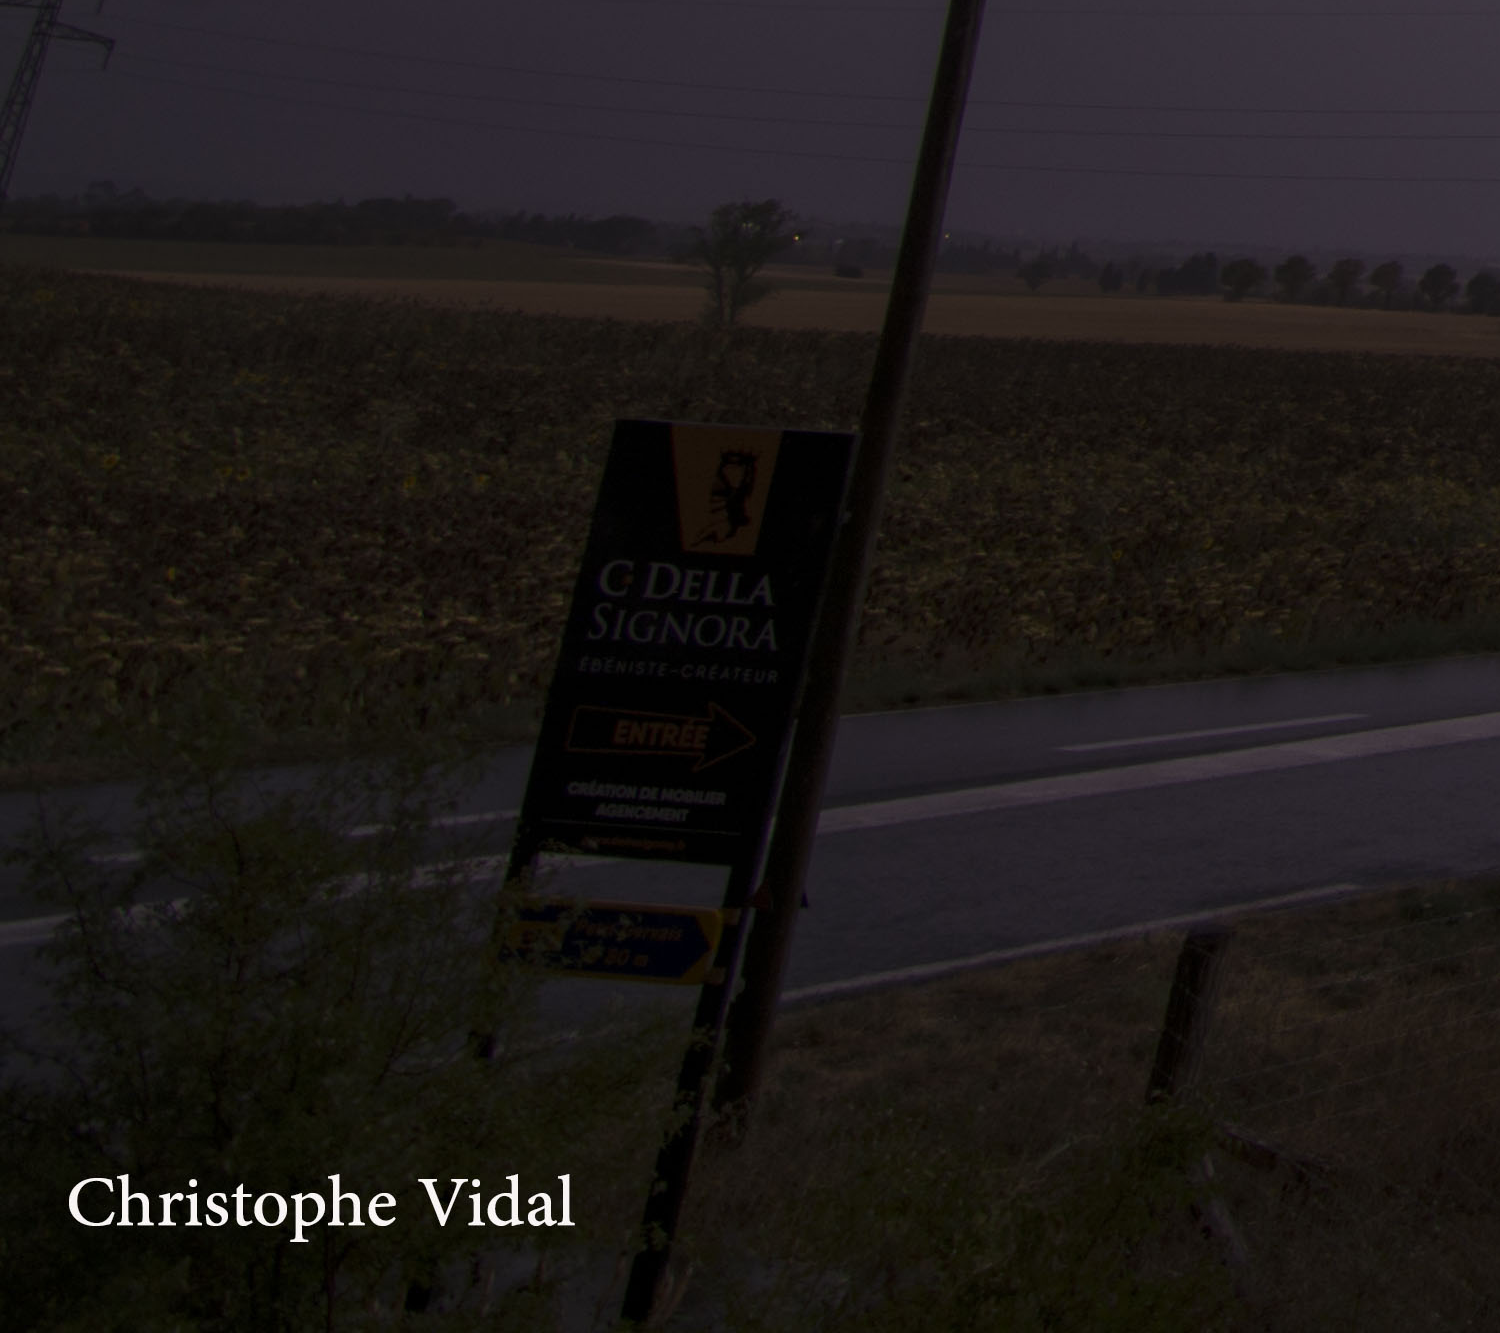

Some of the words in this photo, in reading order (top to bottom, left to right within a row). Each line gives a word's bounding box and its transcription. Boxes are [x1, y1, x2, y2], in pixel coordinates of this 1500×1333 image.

[597, 559, 635, 597] C
[642, 561, 776, 606] DELLA
[586, 602, 779, 652] SIGNORA
[613, 717, 710, 749] ENTRÉE
